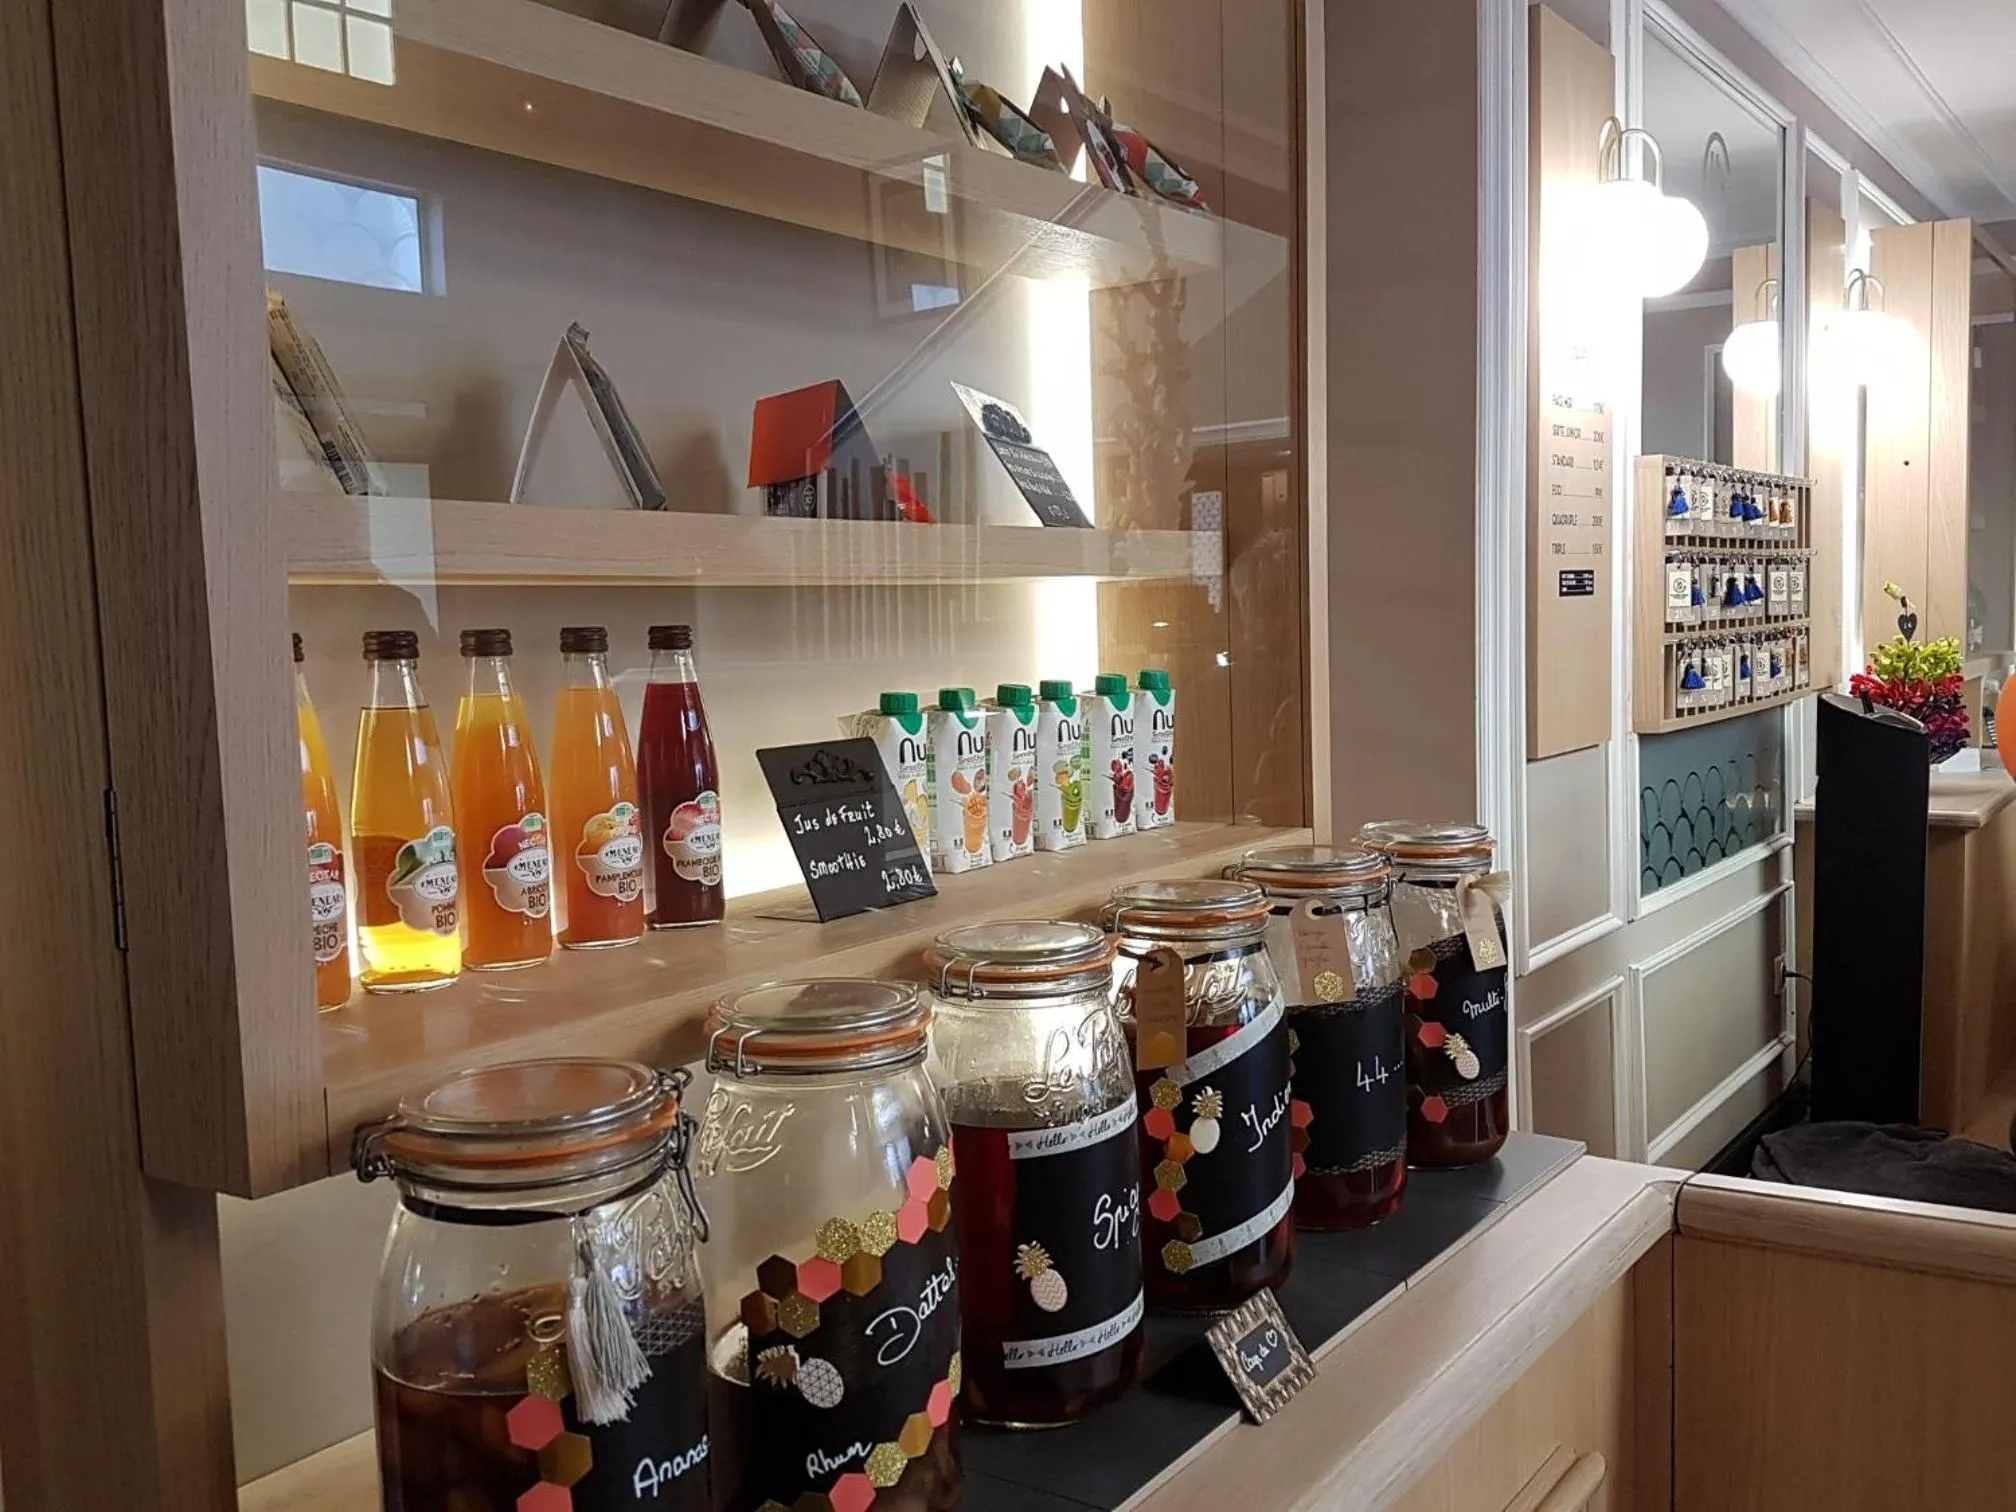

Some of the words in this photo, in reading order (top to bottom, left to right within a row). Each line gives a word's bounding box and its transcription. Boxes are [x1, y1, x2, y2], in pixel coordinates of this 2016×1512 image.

[793, 814, 820, 835] Jus
[703, 864, 719, 878] BIO
[618, 880, 637, 893] BIO
[528, 894, 546, 908] BIO
[436, 912, 456, 928] BIO
[313, 935, 339, 951] BIO
[1036, 1133, 1067, 1150] Hello
[1048, 1339, 1078, 1357] Hello
